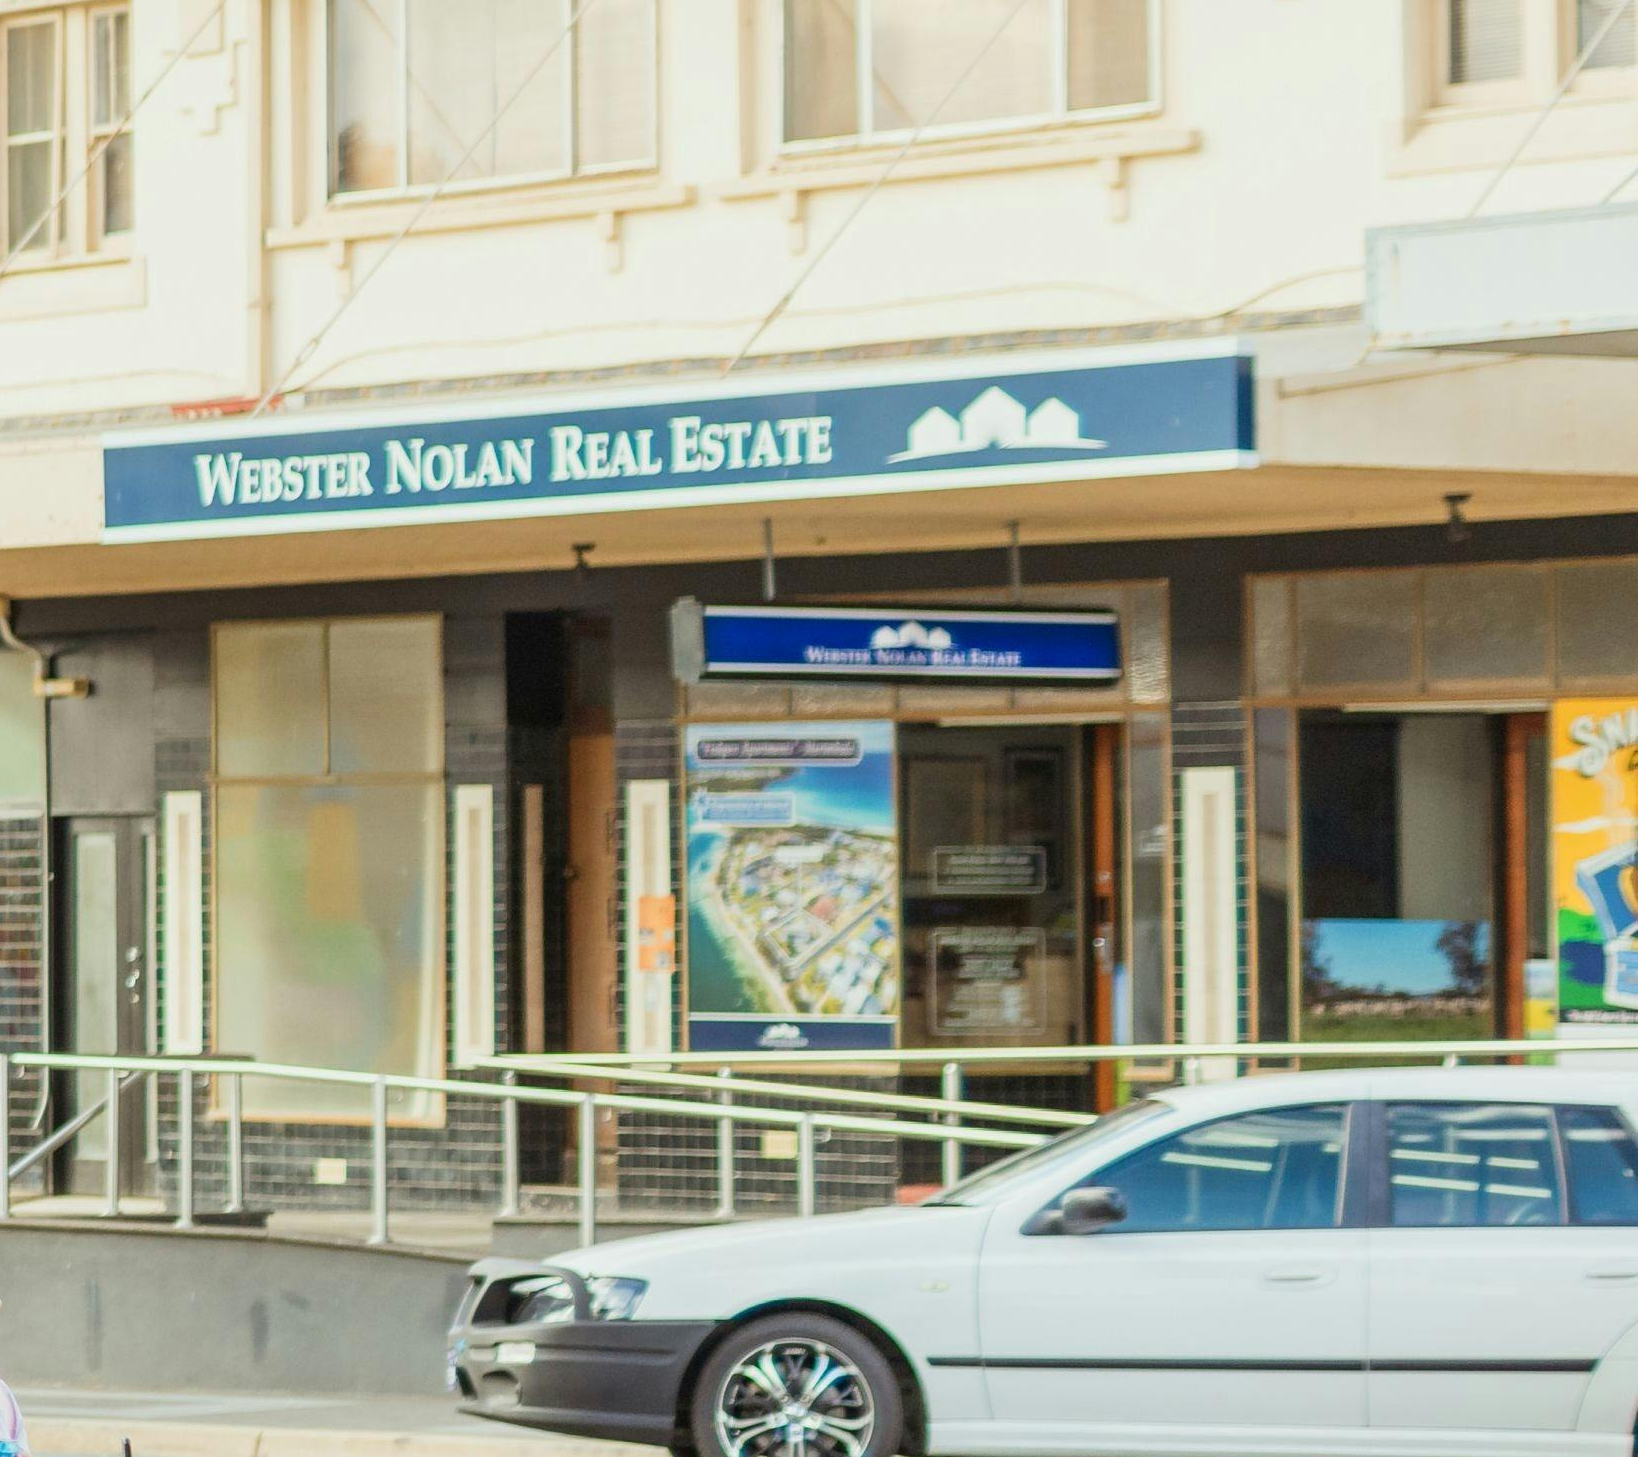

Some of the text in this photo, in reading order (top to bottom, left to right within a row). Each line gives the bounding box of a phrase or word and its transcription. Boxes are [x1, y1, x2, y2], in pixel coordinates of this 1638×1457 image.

[194, 415, 833, 507] WEBSTER NOLAN REAL ESTATE
